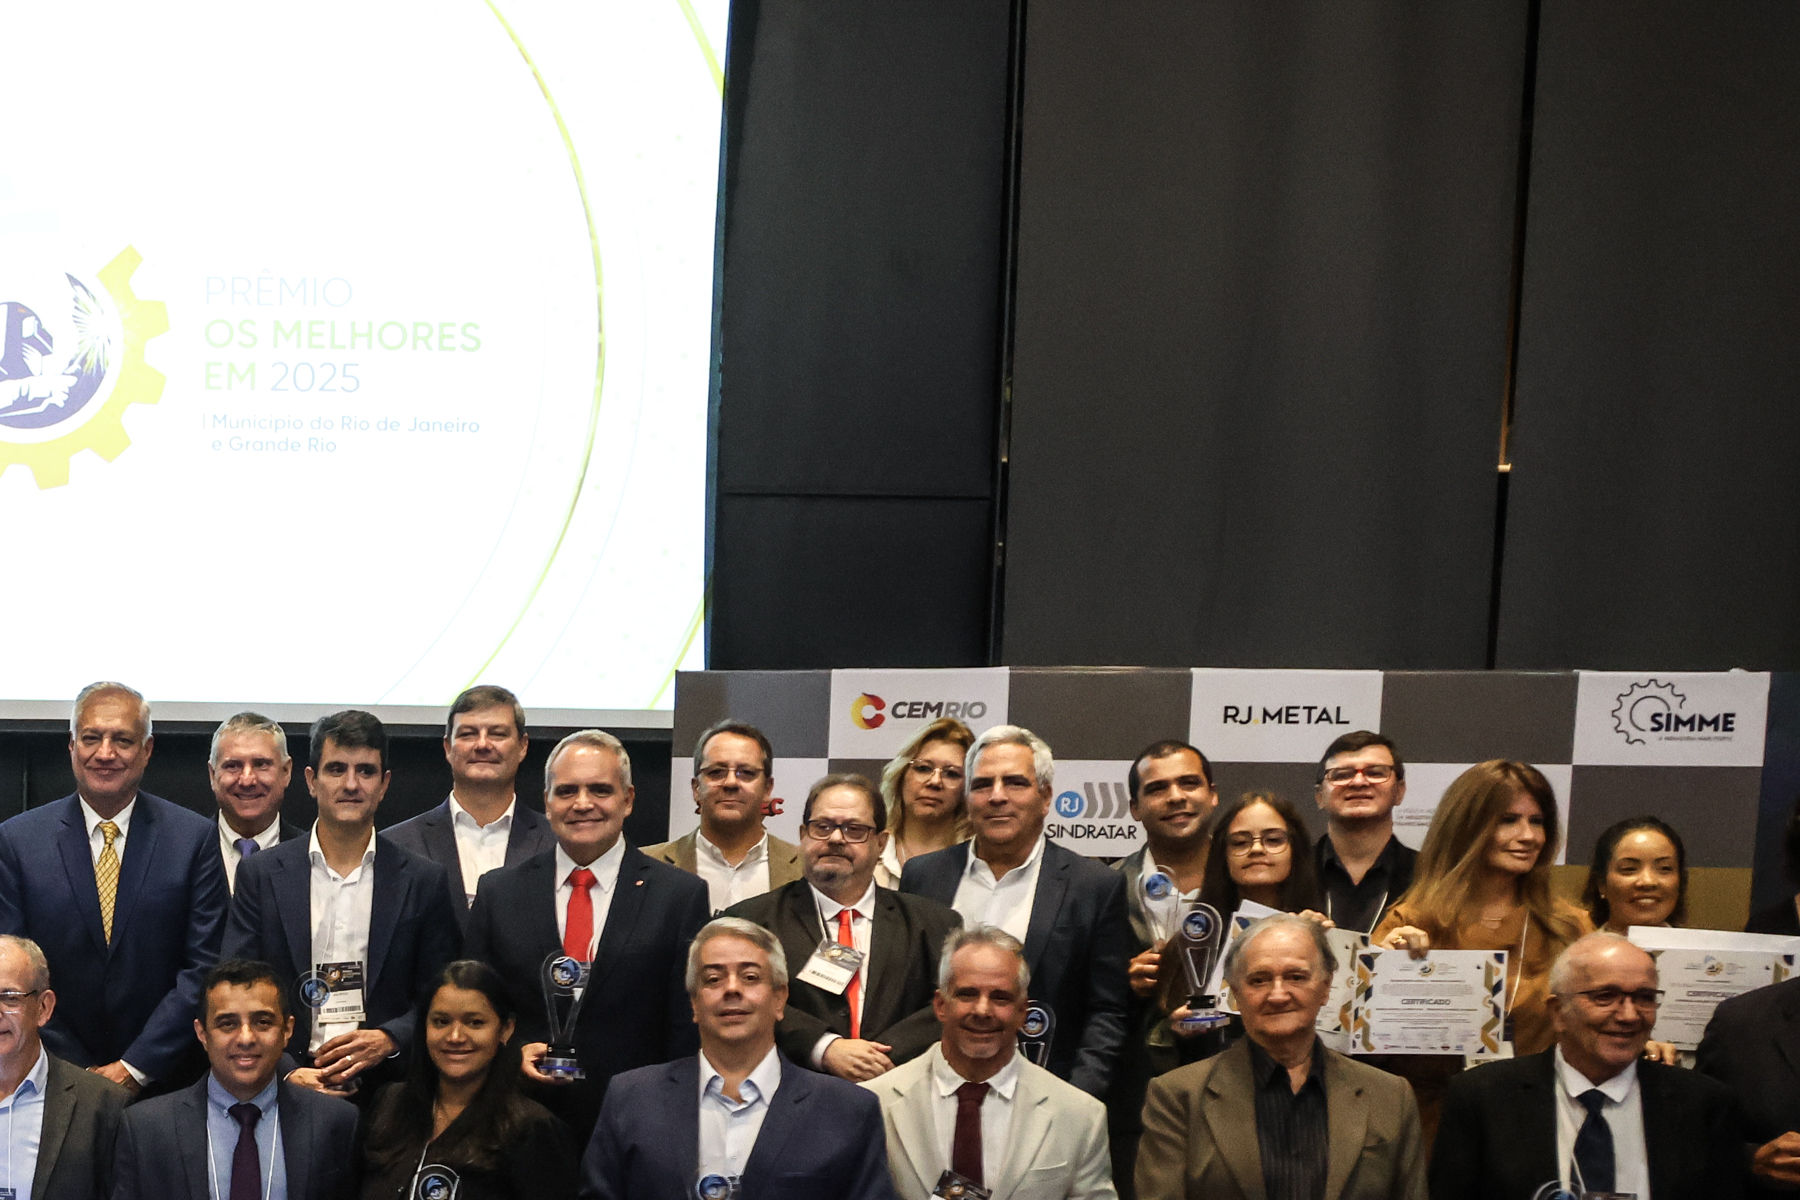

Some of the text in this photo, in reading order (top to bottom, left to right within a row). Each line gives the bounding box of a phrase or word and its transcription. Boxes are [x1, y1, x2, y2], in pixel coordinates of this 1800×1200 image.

[204, 267, 353, 308] PRÊMIO
[203, 317, 483, 354] OS MELHORES
[203, 360, 361, 394] EM 2025
[309, 413, 335, 431] do
[340, 414, 371, 432] Rio
[375, 416, 401, 433] de
[407, 415, 481, 434] Janeiro
[210, 435, 338, 454] e Grande Rio
[891, 701, 987, 719] CEMRIO
[1650, 712, 1736, 732] SIMME
[1060, 796, 1080, 813] RJ
[1043, 823, 1138, 840] SINDRATAR
